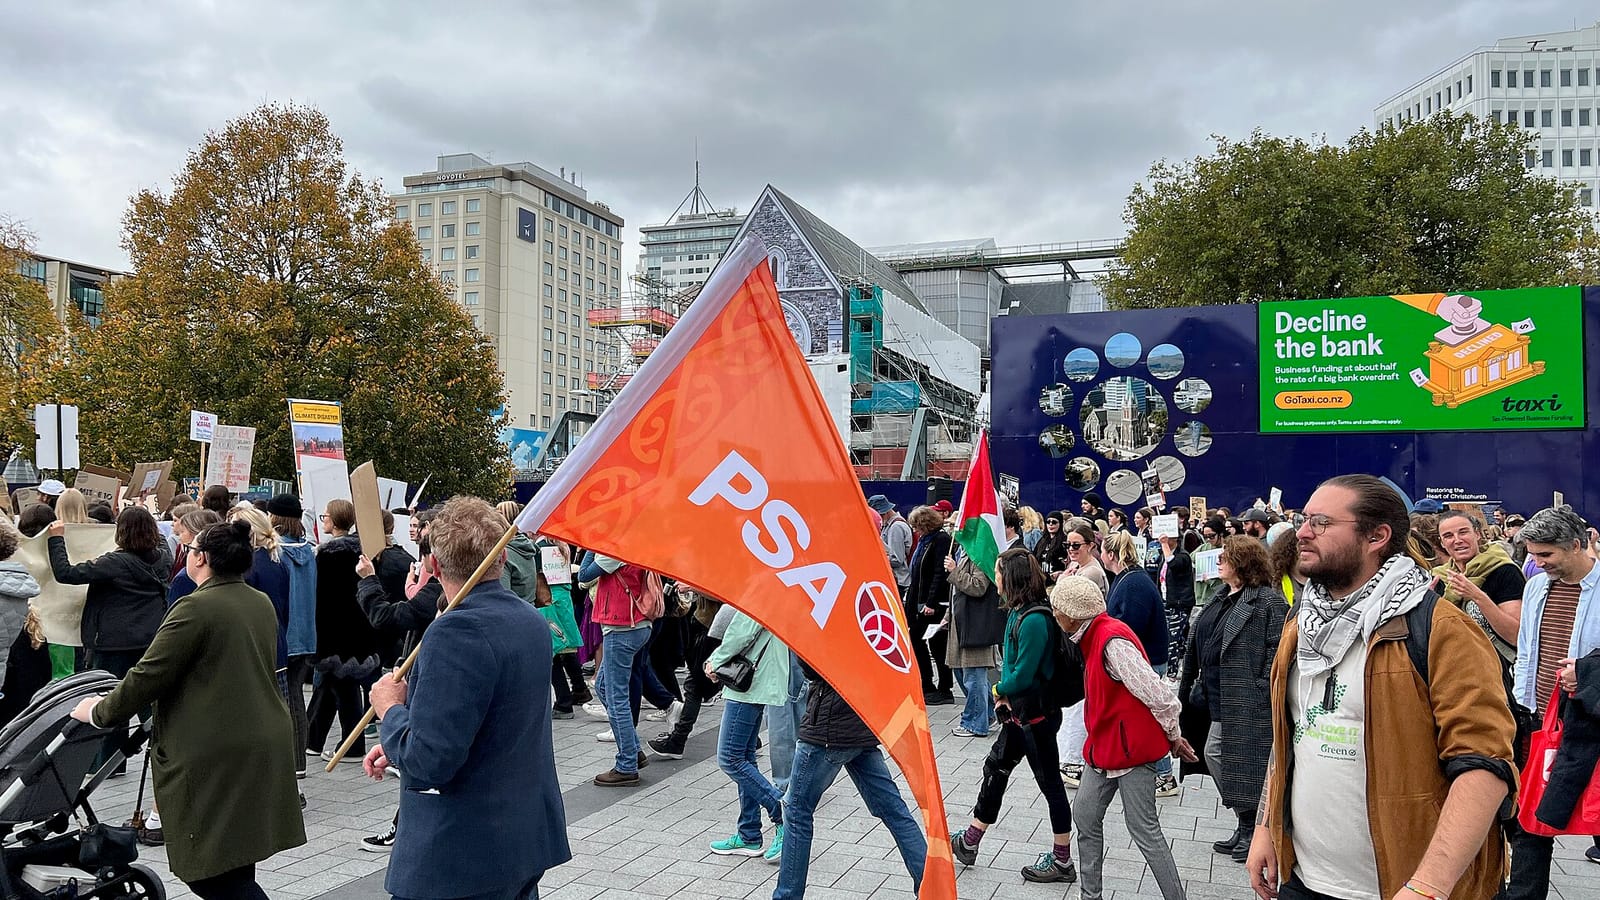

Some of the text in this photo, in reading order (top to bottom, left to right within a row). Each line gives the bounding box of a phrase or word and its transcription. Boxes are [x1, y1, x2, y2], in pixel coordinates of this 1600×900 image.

[437, 173, 466, 181] NOVOTEL
[1275, 309, 1367, 334] Decline
[1274, 333, 1384, 358] the bank
[1454, 331, 1504, 359] DECLINED
[1275, 366, 1311, 374] Business
[1312, 364, 1343, 373] funding
[1380, 362, 1397, 371] half
[1275, 375, 1289, 384] the
[1307, 375, 1317, 383] of
[1323, 374, 1337, 384] big
[1337, 374, 1359, 382] bank
[1359, 372, 1400, 381] overdraft
[1284, 395, 1343, 404] GoTaxi.co.nz
[1501, 393, 1562, 412] taxi
[295, 412, 317, 420] CLIMATE
[687, 449, 847, 631] PSA
[1321, 725, 1360, 737] LOVE IT
[1320, 743, 1348, 756] Green
